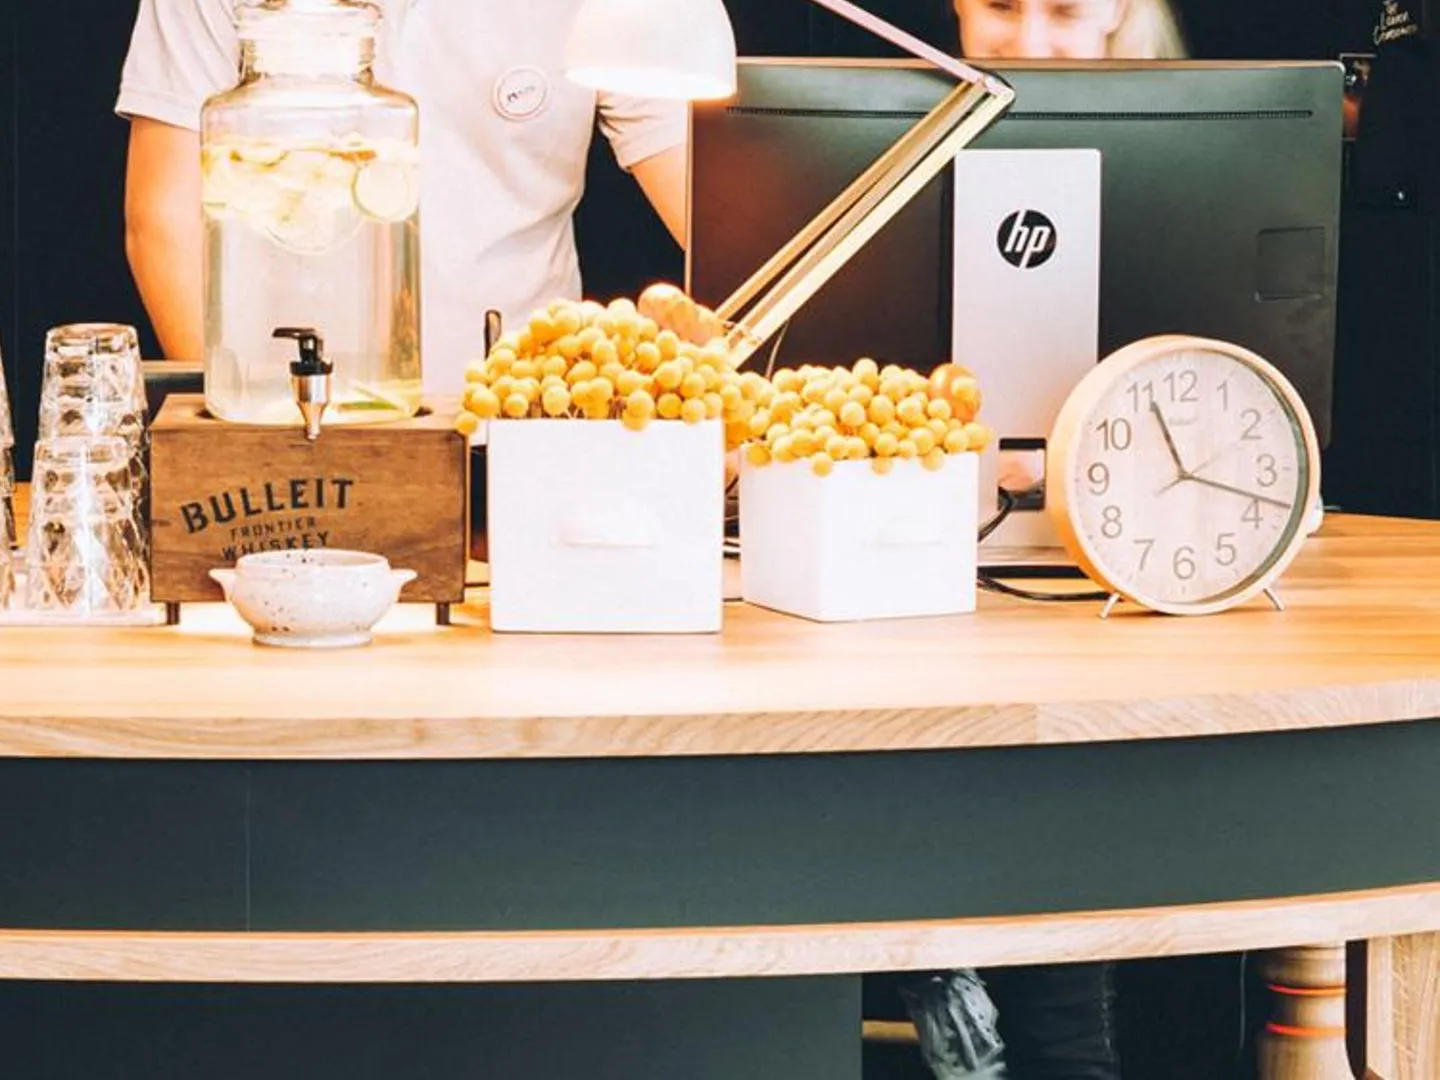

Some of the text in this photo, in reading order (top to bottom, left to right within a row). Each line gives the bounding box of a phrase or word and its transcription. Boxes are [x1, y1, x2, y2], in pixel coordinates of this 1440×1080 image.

[1003, 209, 1052, 269] hp
[1126, 381, 1155, 413] 11
[1162, 370, 1199, 402] 12
[1216, 380, 1229, 410] 1
[1095, 418, 1132, 451] 10
[1240, 407, 1263, 441] 2
[1087, 462, 1110, 496] 9
[1255, 453, 1278, 488] 3
[179, 478, 354, 534] BULLEIT
[1100, 505, 1123, 539] 8
[1240, 497, 1264, 530] 4
[229, 516, 316, 542] FRONTIER
[1132, 538, 1156, 571] 7
[1172, 546, 1196, 581] 6
[1215, 532, 1237, 566] 5
